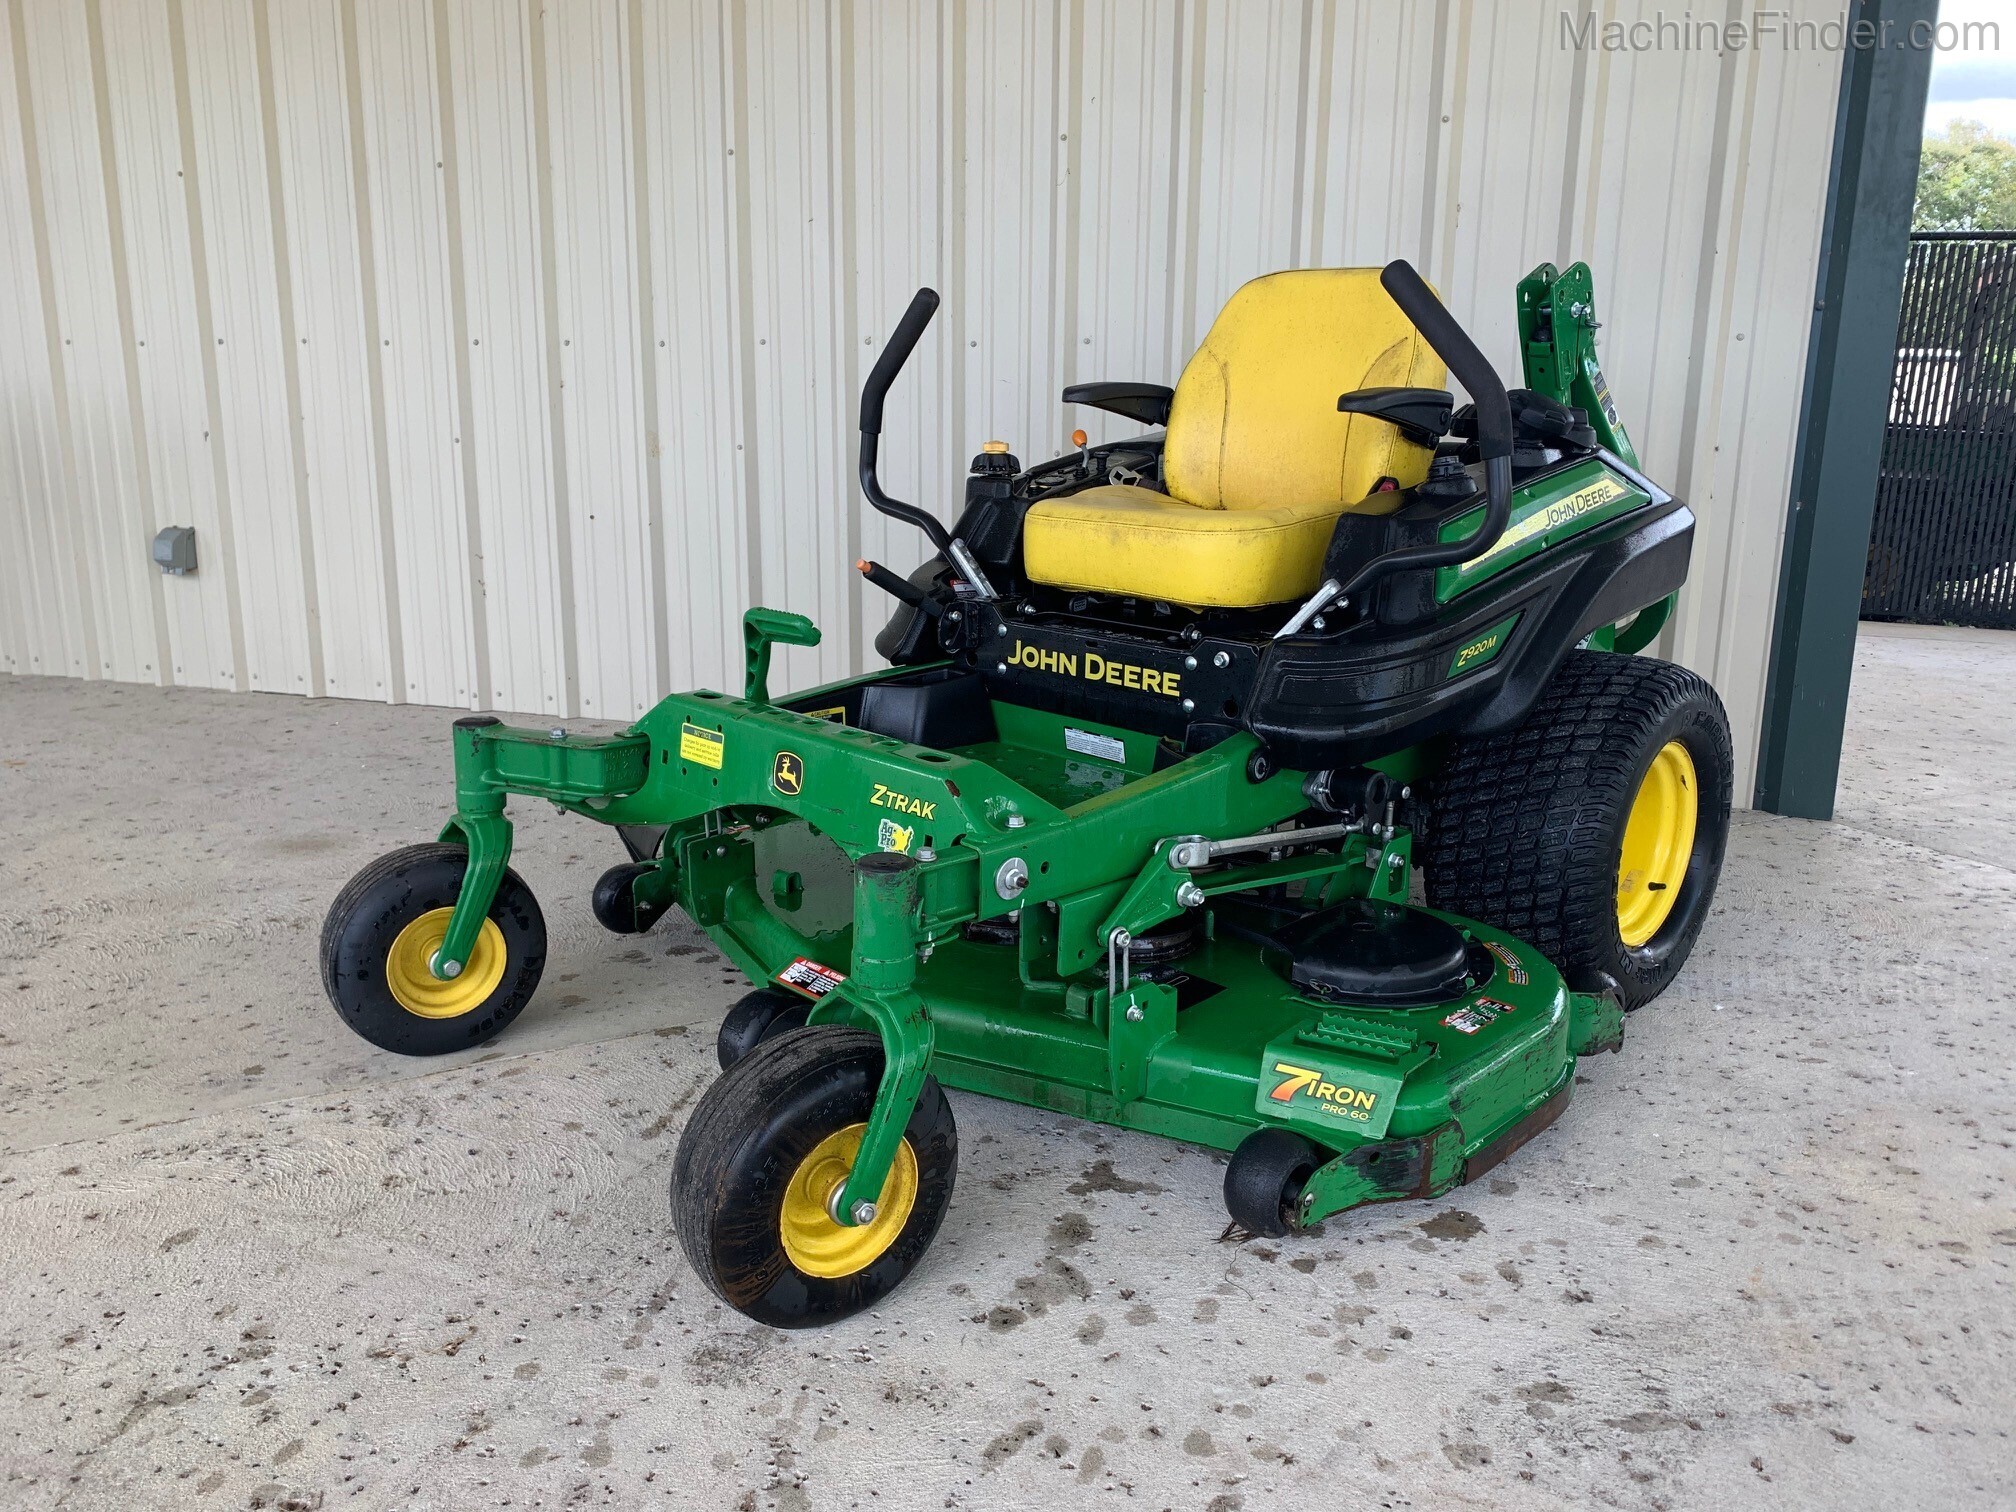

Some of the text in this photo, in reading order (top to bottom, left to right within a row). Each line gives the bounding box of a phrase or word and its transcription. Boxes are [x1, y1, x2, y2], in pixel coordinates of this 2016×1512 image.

[1545, 485, 1612, 529] JOHN DEERE
[1007, 639, 1181, 697] JOHN DEERE
[1457, 634, 1497, 667] Z920M
[870, 783, 937, 820] ZTRAK
[881, 834, 896, 847] Pro
[1321, 1102, 1369, 1121] PRO 60
